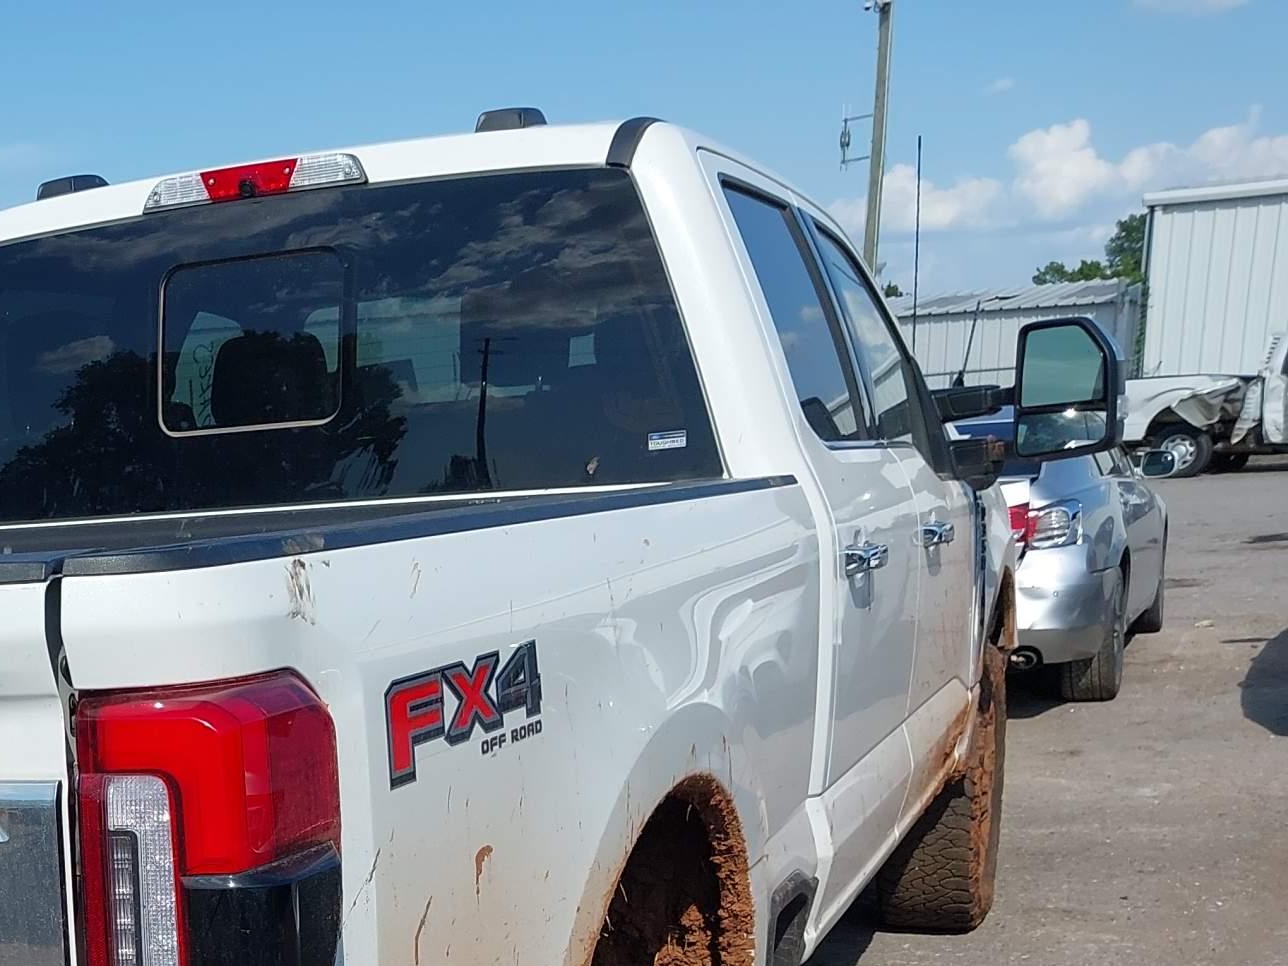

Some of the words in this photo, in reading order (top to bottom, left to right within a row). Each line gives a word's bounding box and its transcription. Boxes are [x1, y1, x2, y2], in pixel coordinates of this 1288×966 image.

[384, 639, 542, 791] FX4
[481, 732, 507, 755] OFF
[510, 719, 543, 744] ROAD
